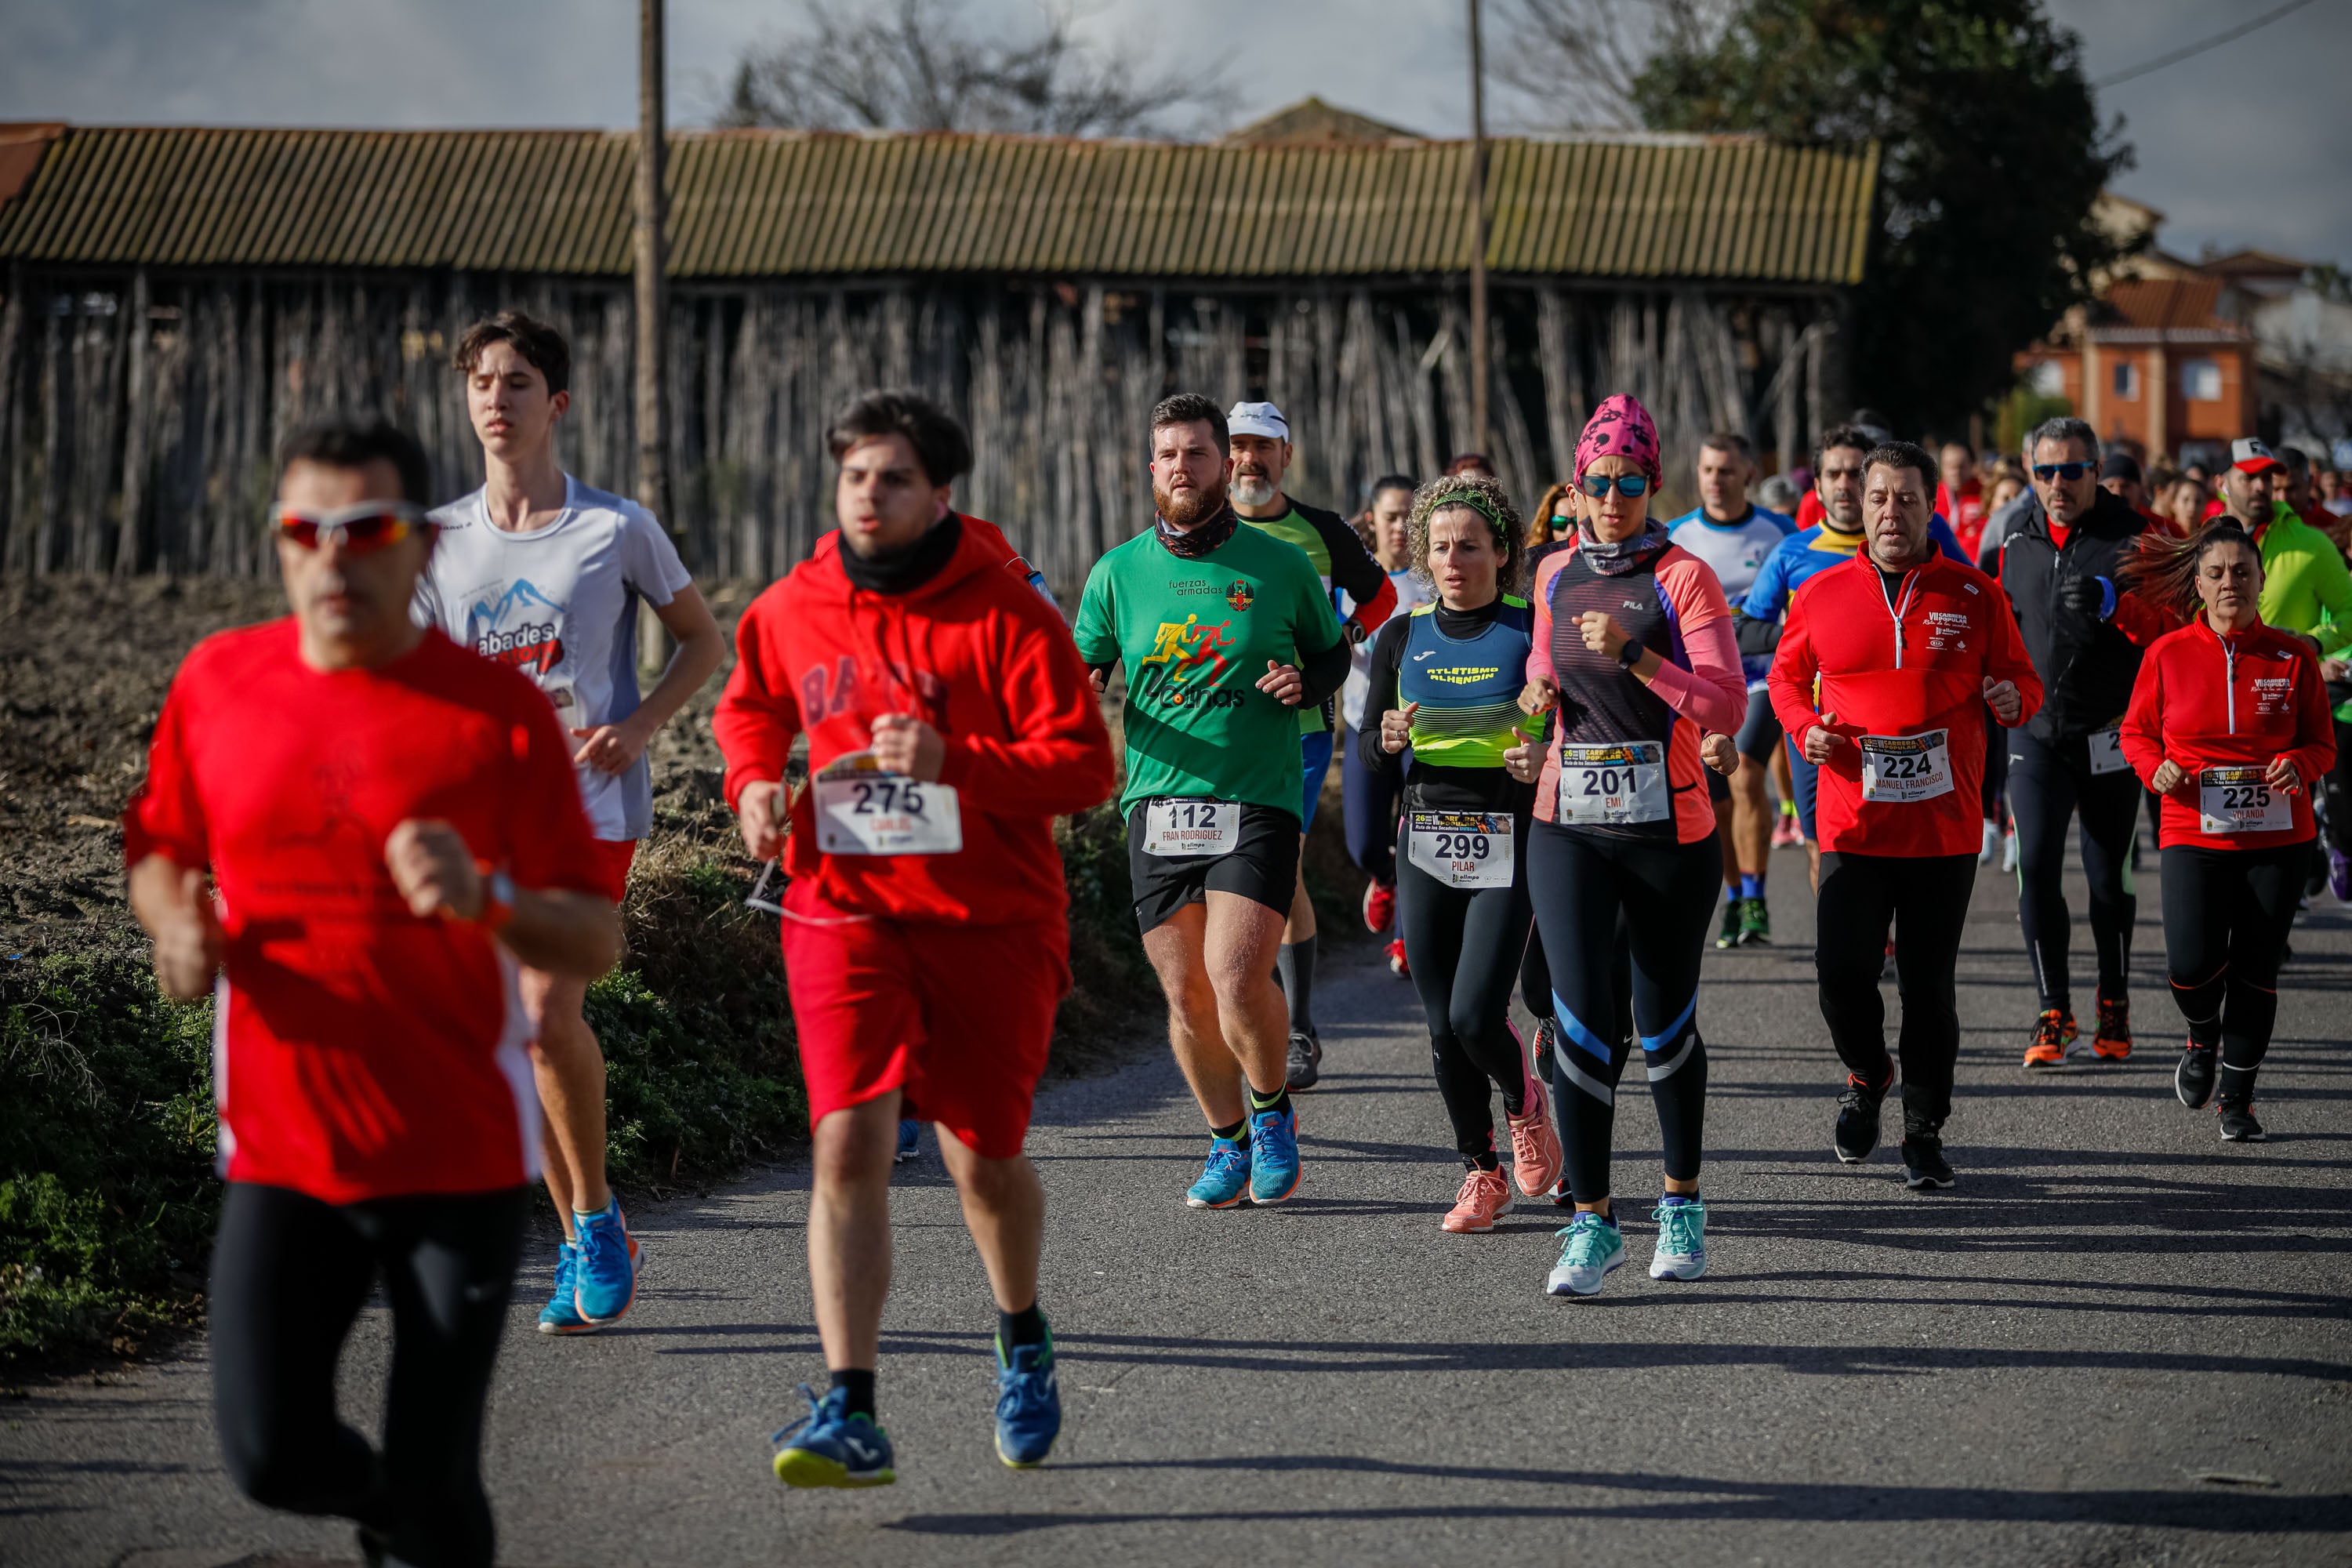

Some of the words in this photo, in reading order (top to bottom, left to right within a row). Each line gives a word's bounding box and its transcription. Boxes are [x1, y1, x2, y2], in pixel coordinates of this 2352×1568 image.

[1169, 579, 1207, 589] fuerzas
[1177, 586, 1222, 596] armadas
[1623, 601, 1643, 611] FILA
[477, 622, 555, 657] abades
[1430, 673, 1494, 684] ALHENDÍN
[1883, 753, 1932, 779] 224
[1582, 768, 1636, 796] 201
[1875, 779, 1904, 789] MANUEL
[1906, 771, 1944, 789] FRANCISCO
[852, 784, 924, 815] 275
[1605, 797, 1621, 808] EMI
[2223, 786, 2270, 809] 225
[1169, 804, 1216, 828] 112
[2233, 809, 2265, 819] YOLANDA
[1163, 831, 1178, 841] FRAN
[1181, 830, 1222, 840] RODRIGUEZ
[1435, 833, 1490, 860] 299
[1452, 861, 1475, 872] PILAR
